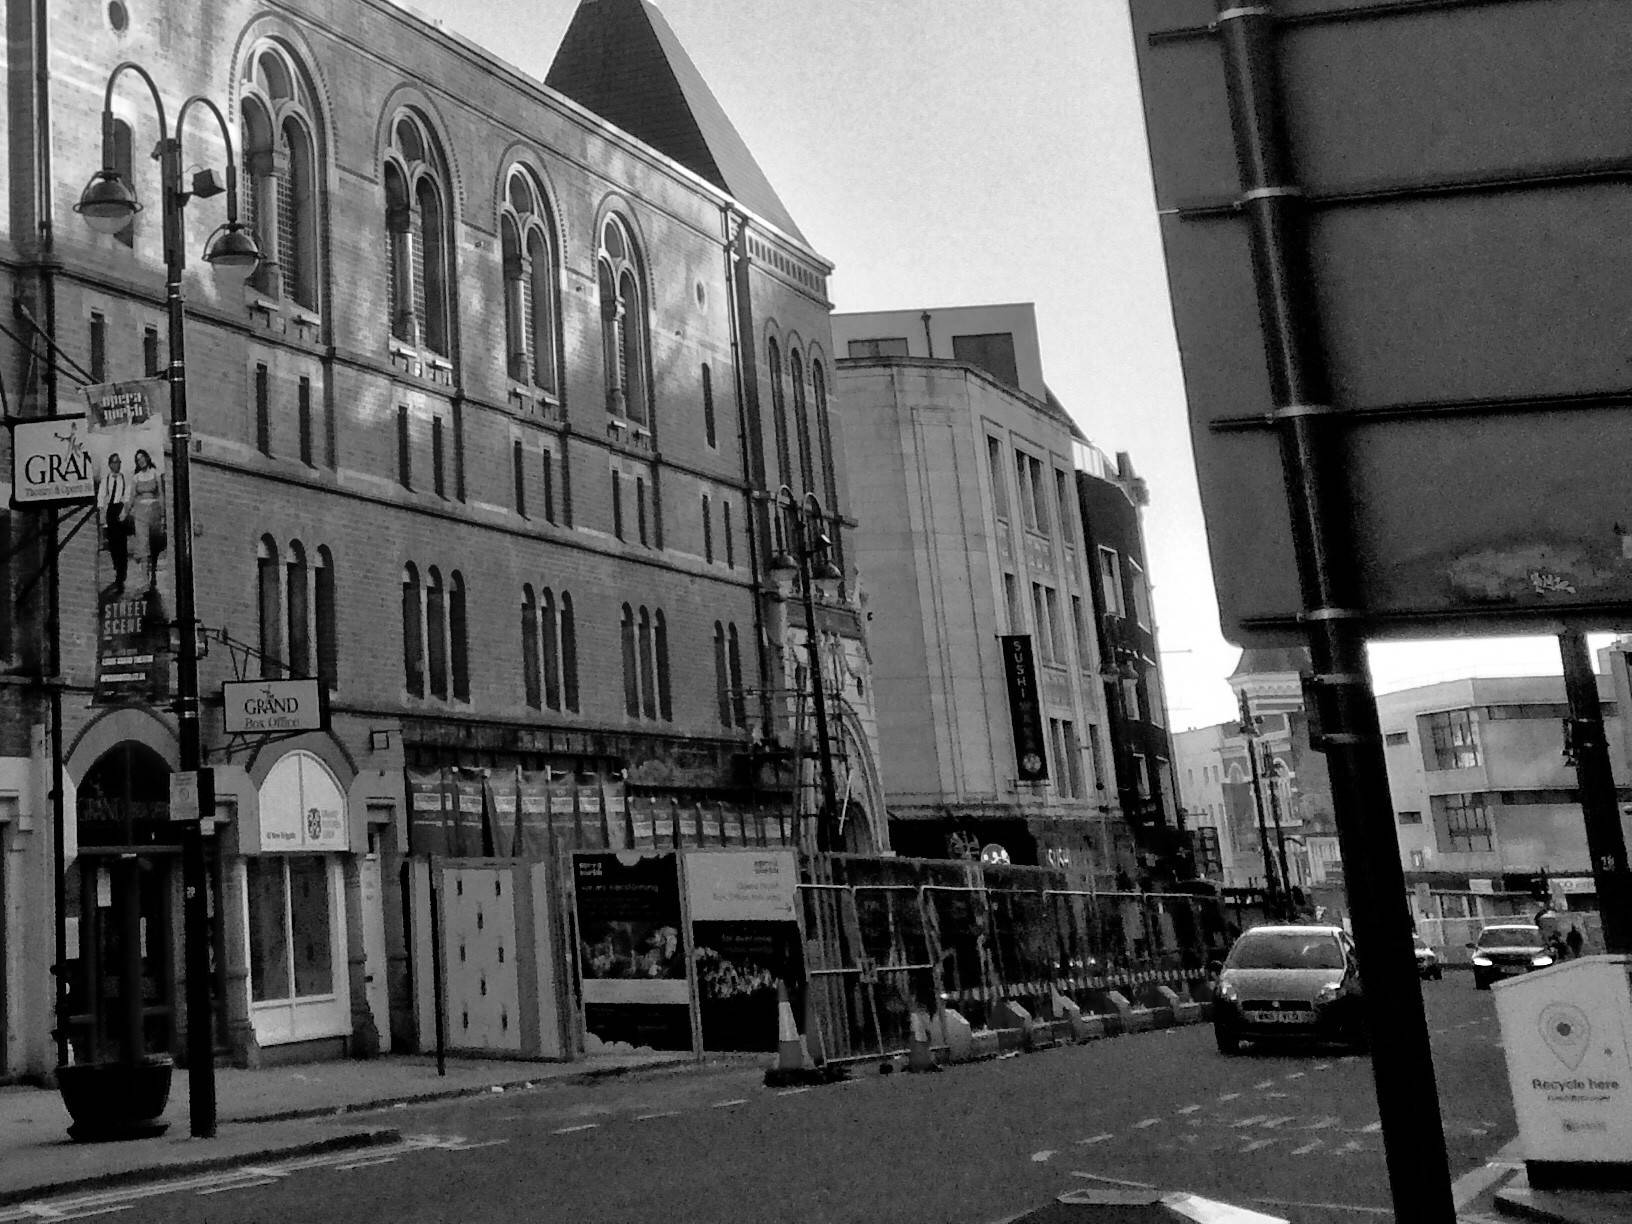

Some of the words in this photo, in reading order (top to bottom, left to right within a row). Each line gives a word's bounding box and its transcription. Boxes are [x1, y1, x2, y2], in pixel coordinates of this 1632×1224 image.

[24, 450, 92, 485] GRAN
[105, 600, 148, 618] STREET
[104, 617, 142, 635] SCENE
[1013, 640, 1026, 699] SUSHI
[244, 697, 299, 715] GRAND
[244, 717, 265, 729] Box
[268, 716, 300, 728] Office
[1532, 1078, 1585, 1092] Recycle
[1588, 1078, 1619, 1090] here
